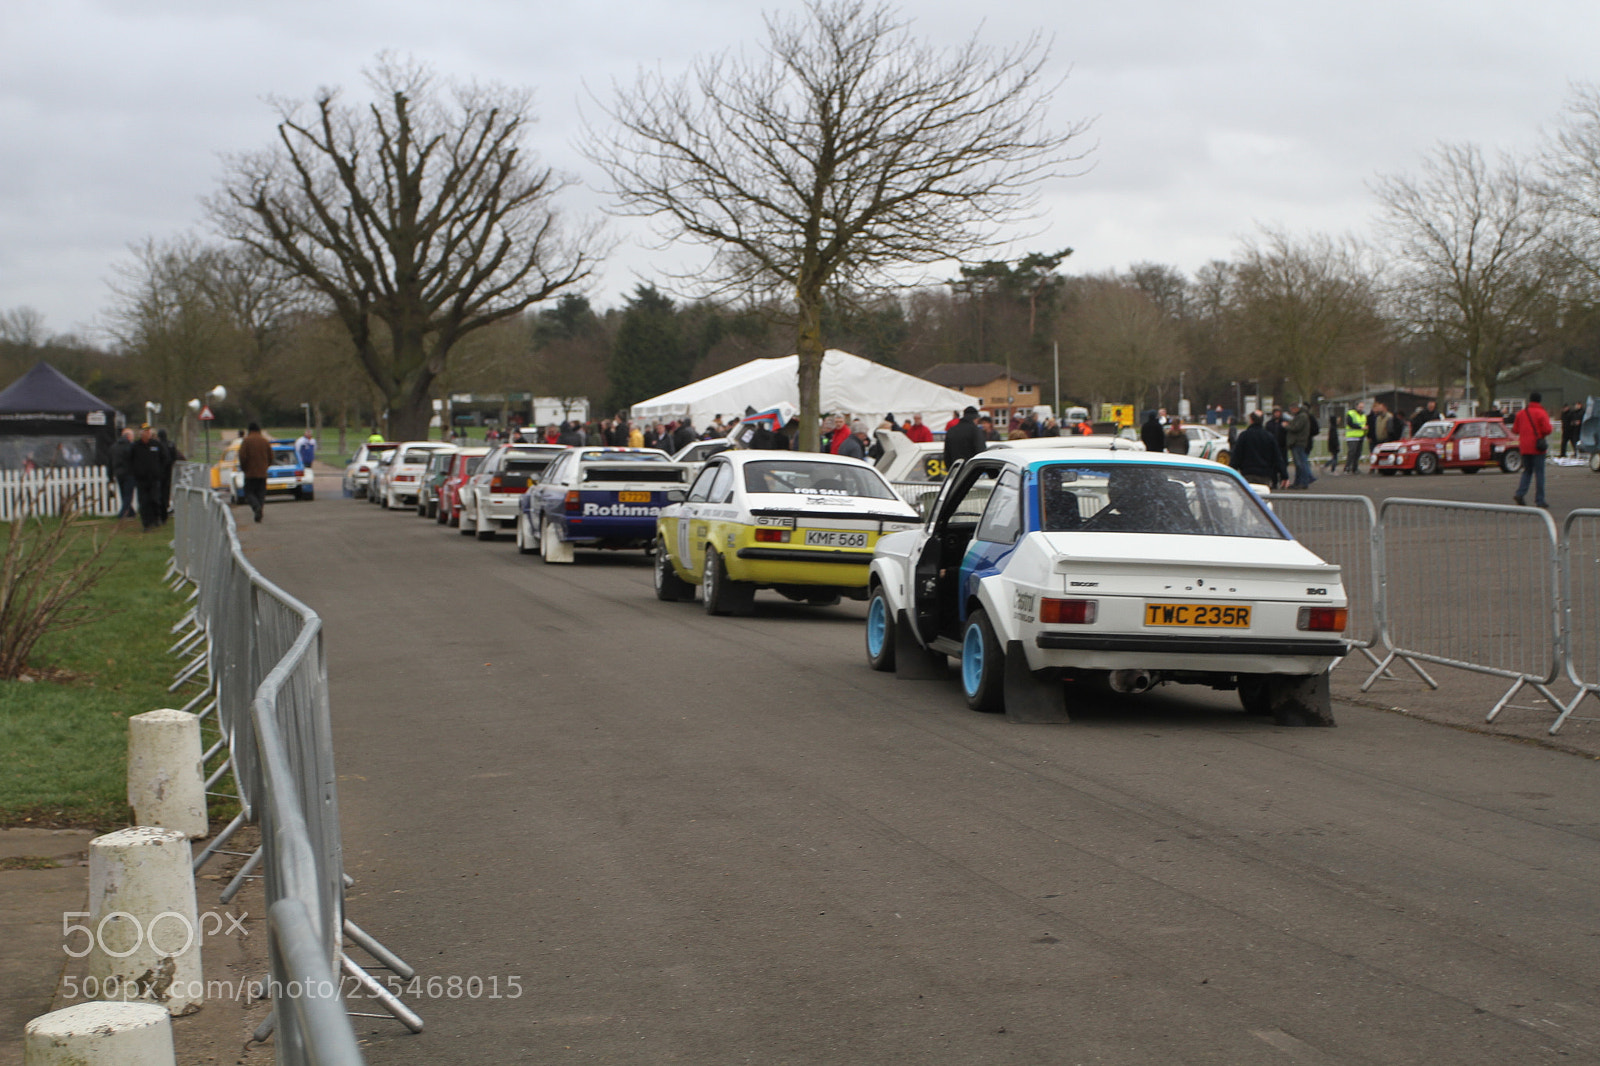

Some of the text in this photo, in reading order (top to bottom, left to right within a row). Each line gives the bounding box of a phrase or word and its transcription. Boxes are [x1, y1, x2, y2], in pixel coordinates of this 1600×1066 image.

[794, 487, 848, 496] FOR SALE
[583, 503, 660, 516] Rothma
[808, 533, 865, 546] KMF 568
[1149, 606, 1249, 625] TWC 235R
